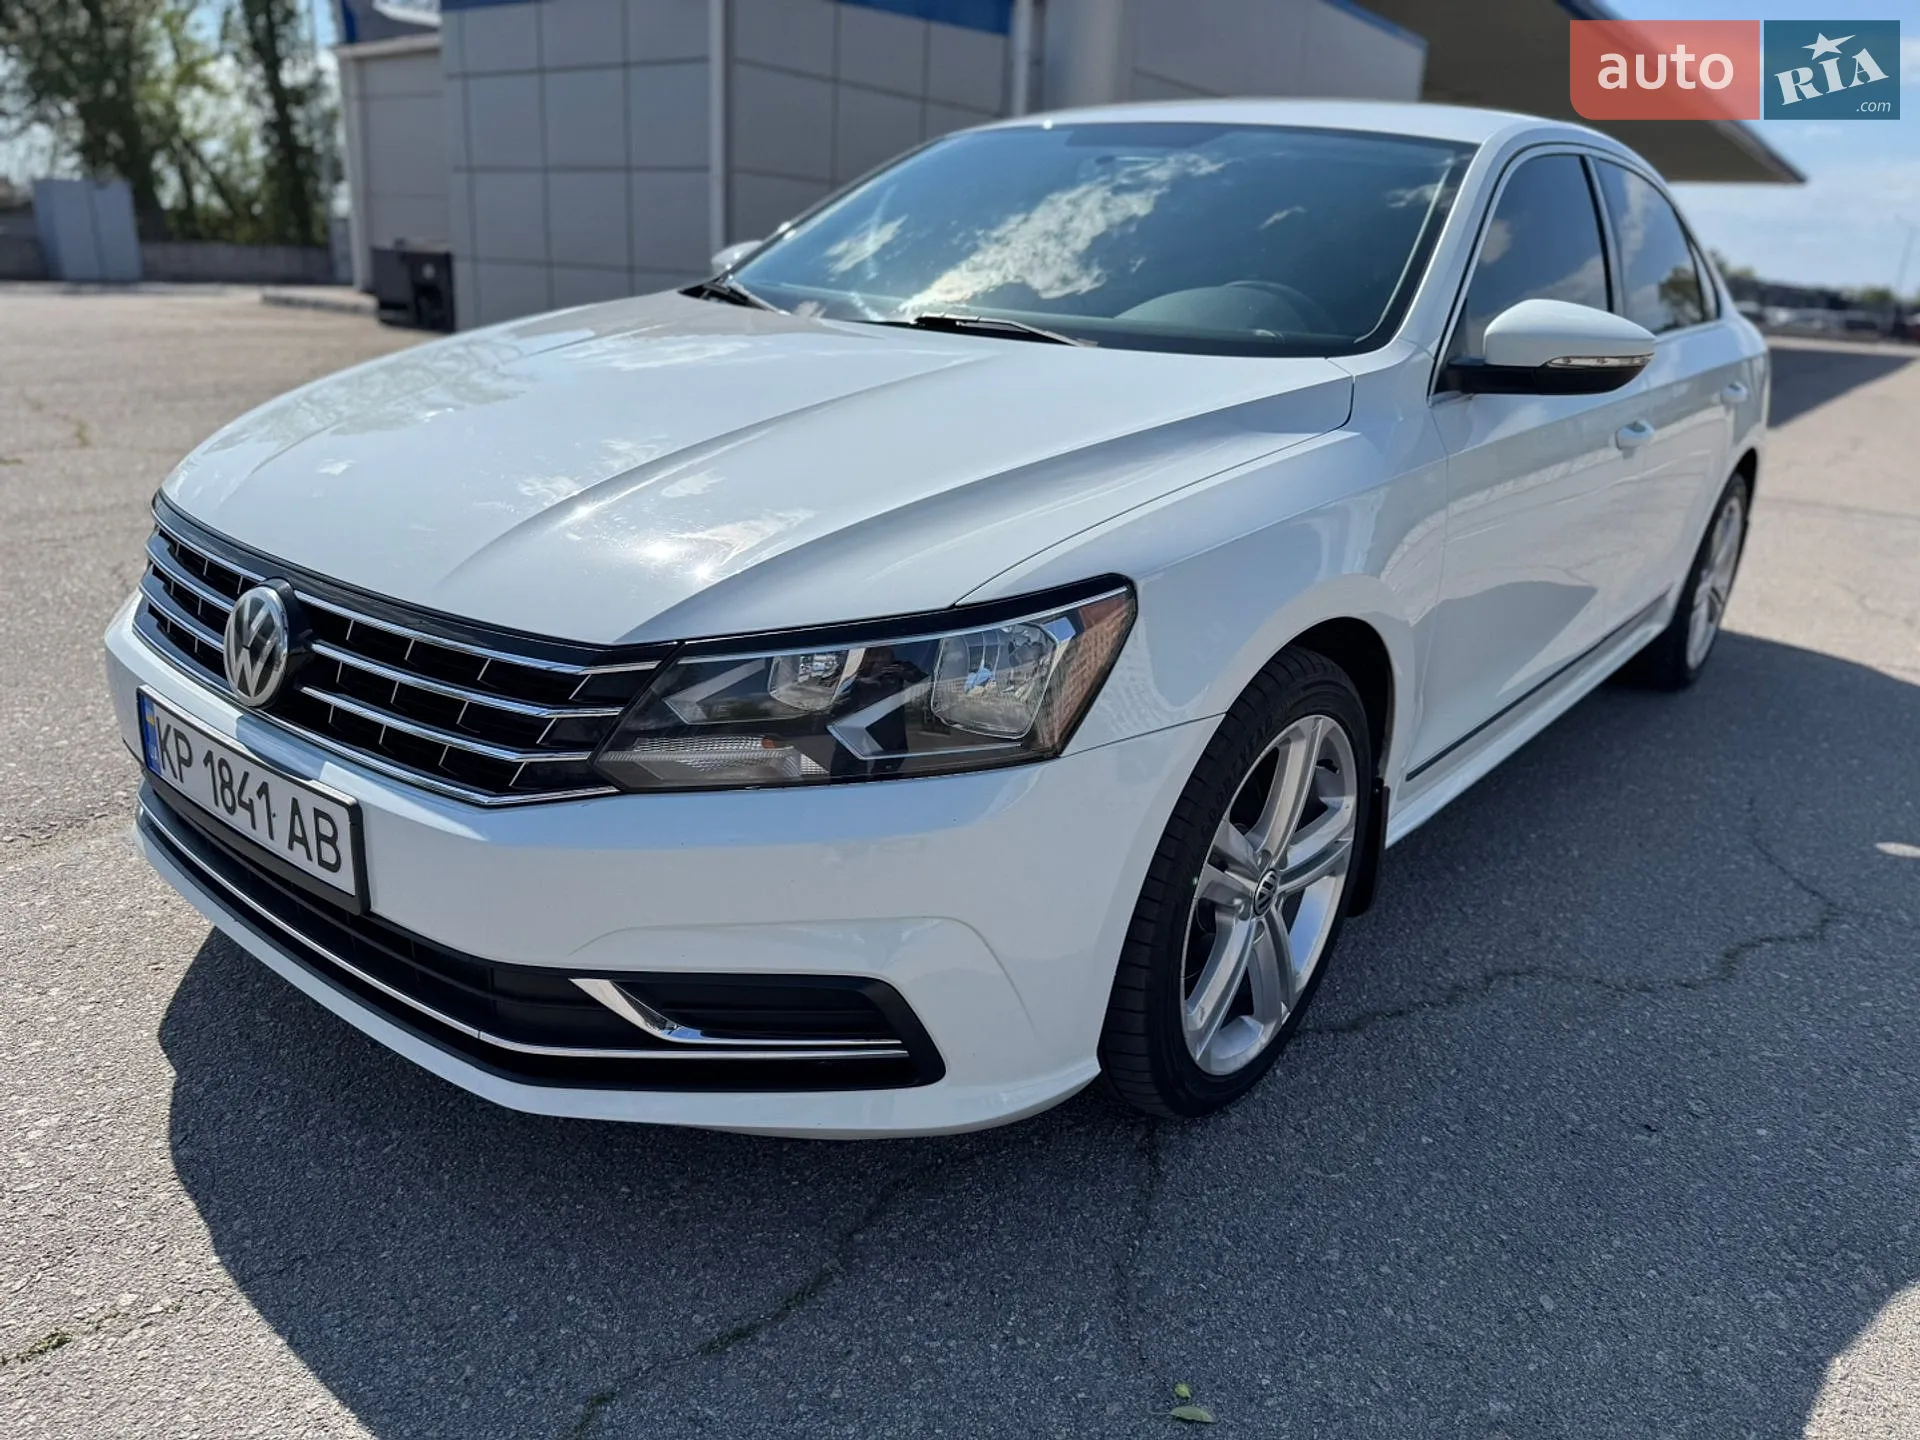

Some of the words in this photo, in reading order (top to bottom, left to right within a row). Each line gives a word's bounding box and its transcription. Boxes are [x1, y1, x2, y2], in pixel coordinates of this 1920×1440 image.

[156, 716, 193, 784] KP
[203, 750, 275, 841] 1841
[288, 797, 342, 874] AB
